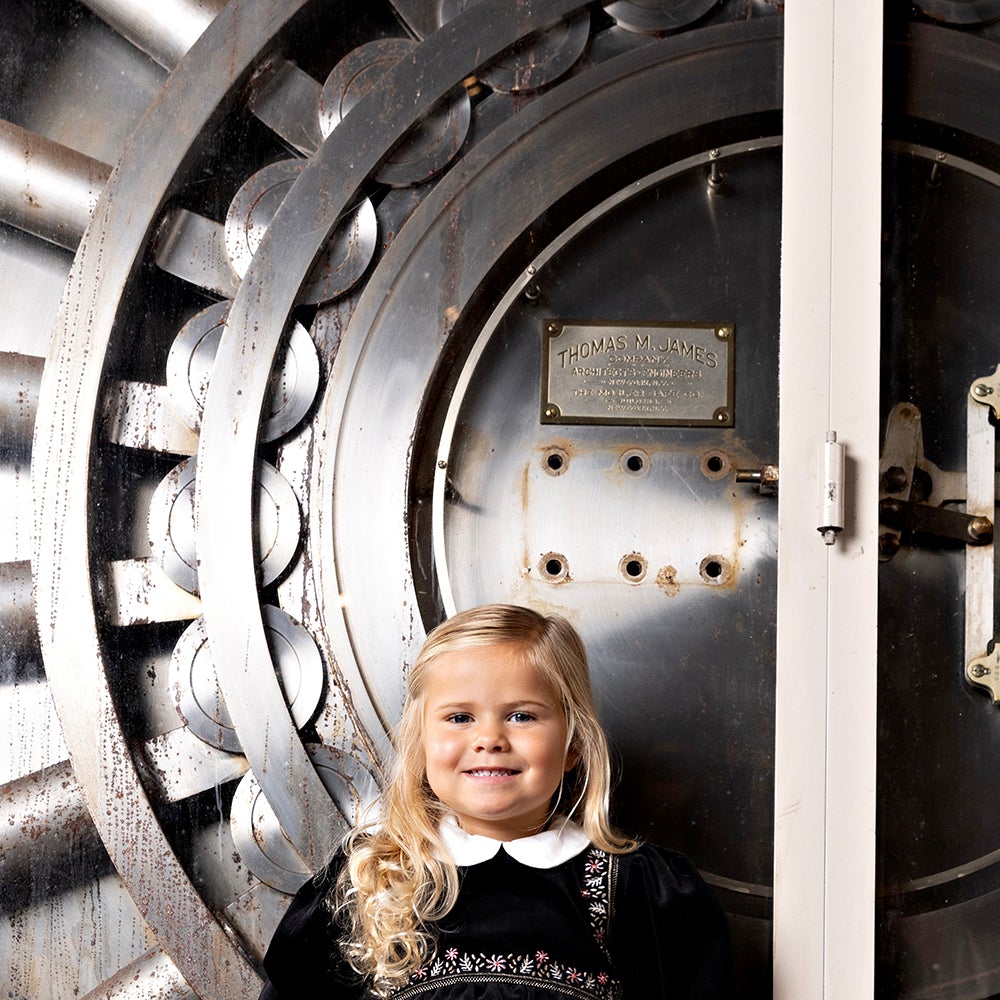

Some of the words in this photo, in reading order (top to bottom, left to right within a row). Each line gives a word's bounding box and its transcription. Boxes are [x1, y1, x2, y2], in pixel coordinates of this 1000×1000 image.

[557, 335, 628, 369] THOMAS
[635, 334, 656, 352] M.
[658, 336, 718, 369] JAMES
[608, 354, 669, 364] COMPANY
